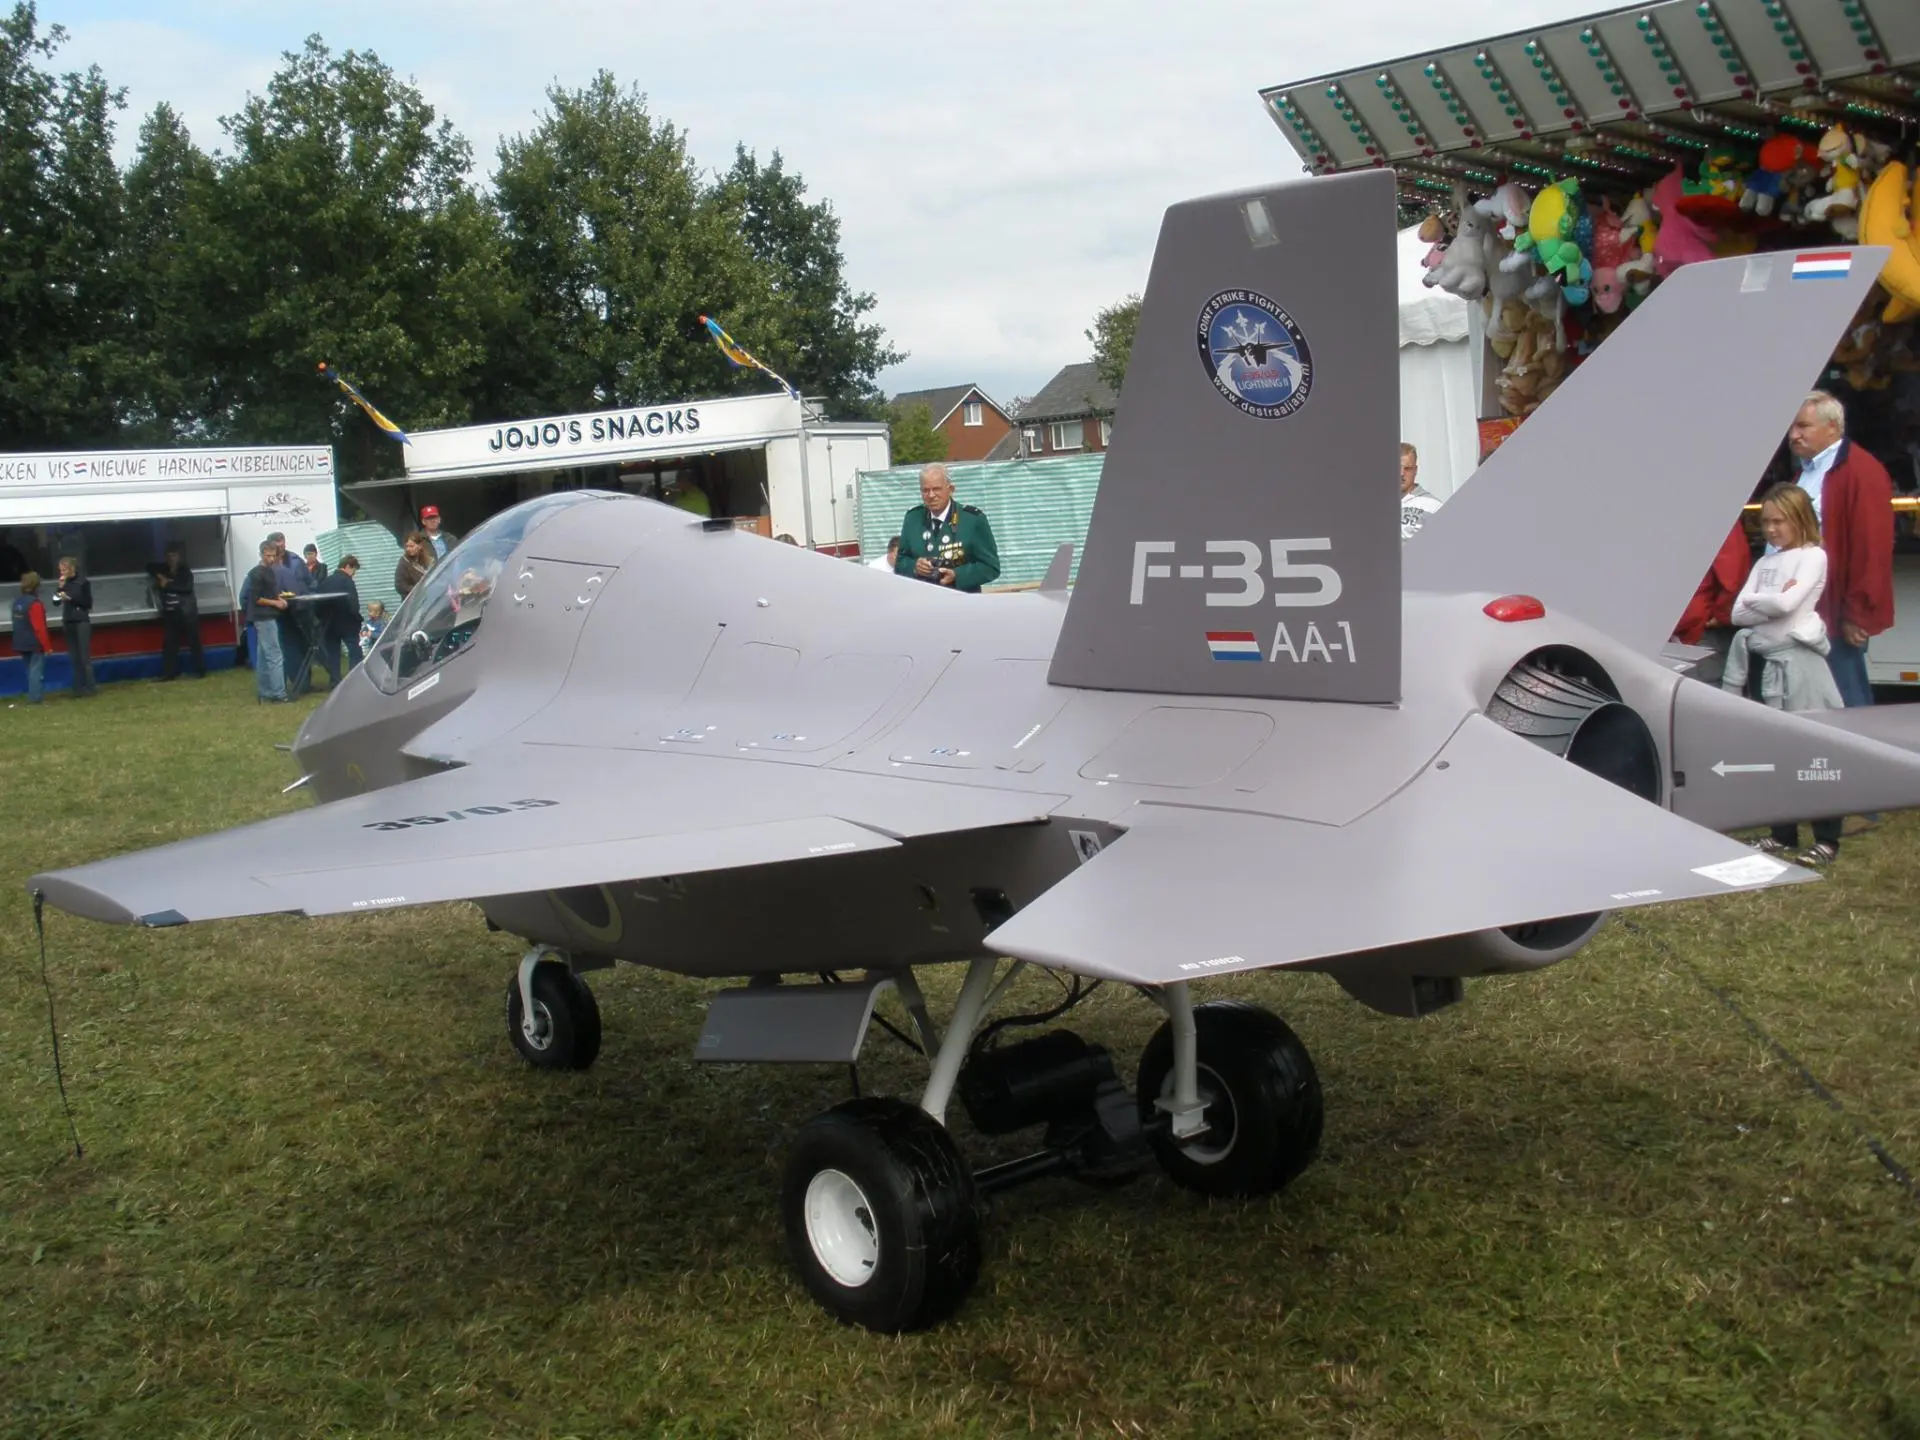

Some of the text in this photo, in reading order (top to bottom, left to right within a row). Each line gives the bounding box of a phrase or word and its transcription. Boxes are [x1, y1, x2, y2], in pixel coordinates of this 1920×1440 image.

[1200, 291, 1294, 338] JOINT STRIKE FIGHTER
[1238, 377, 1283, 391] LIGHTNING
[488, 407, 700, 452] JOJO'S SNACKS
[48, 461, 70, 479] VIS
[90, 459, 147, 477] NIEUWE
[158, 457, 212, 477] HARING
[230, 454, 315, 474] KIBBELINGEN
[1130, 537, 1343, 607] F-35
[1269, 621, 1357, 663] AA-1
[1797, 769, 1841, 781] EXHAUST
[1810, 758, 1828, 769] JET
